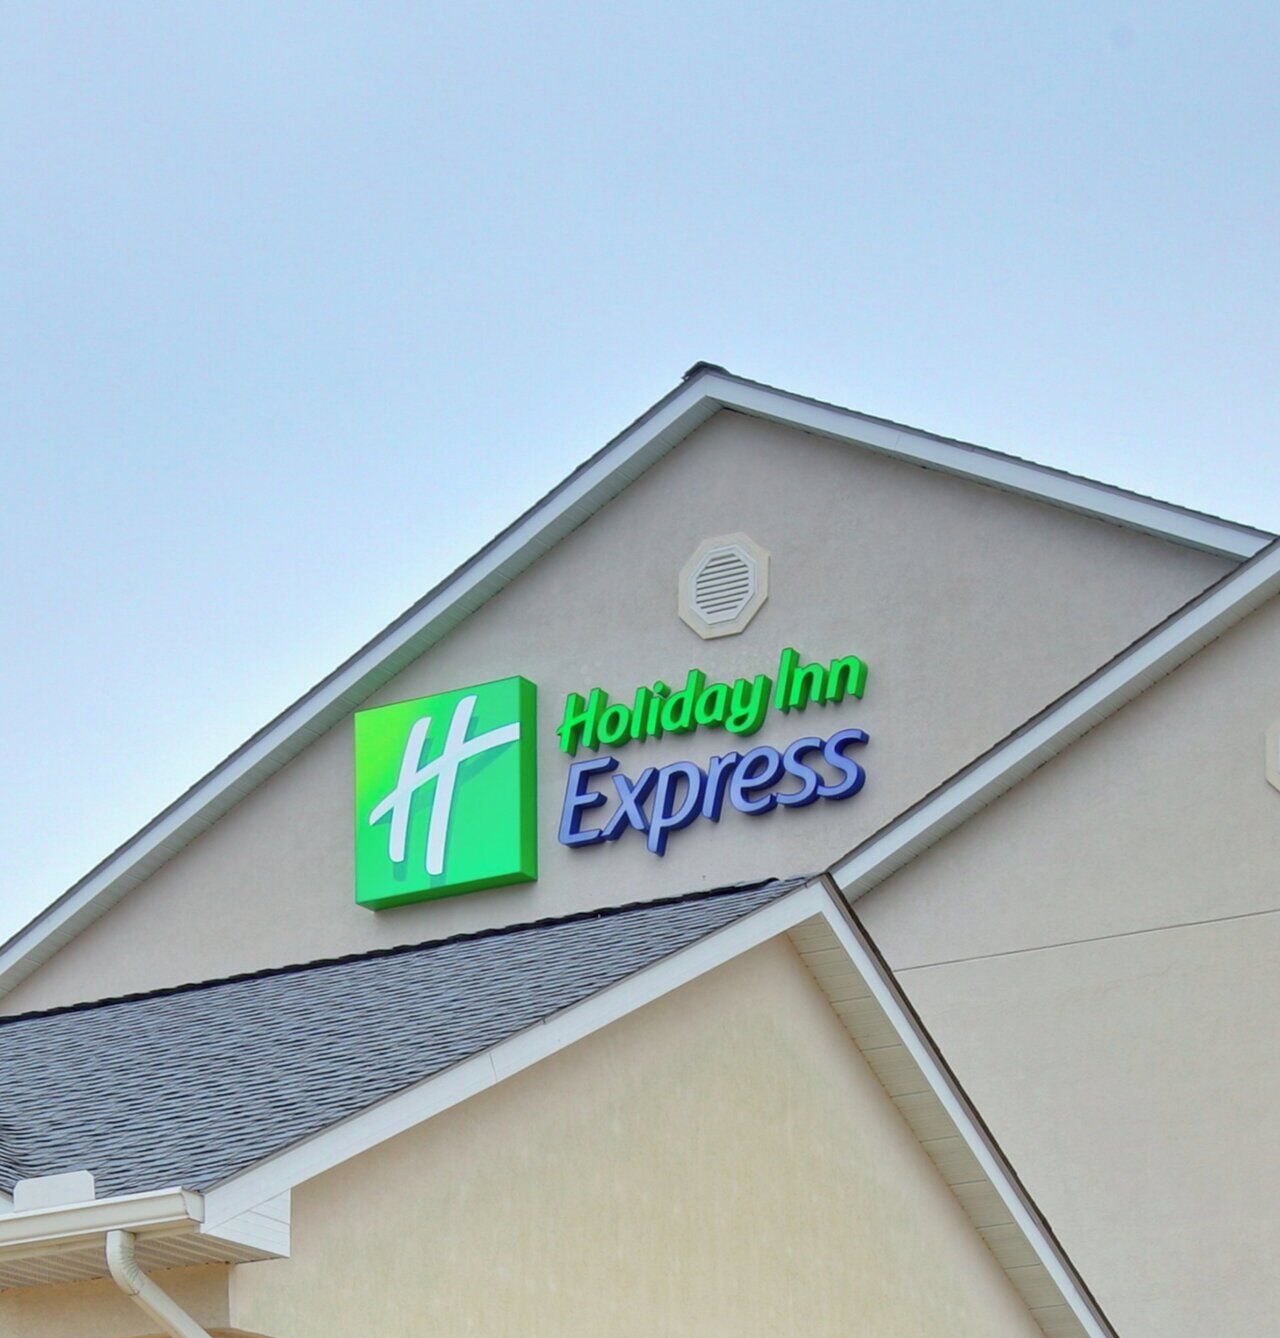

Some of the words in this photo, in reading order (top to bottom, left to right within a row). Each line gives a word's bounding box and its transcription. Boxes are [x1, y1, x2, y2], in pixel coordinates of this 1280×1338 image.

[556, 669, 772, 756] Holiday
[774, 647, 868, 714] Inn
[369, 694, 520, 876] H
[558, 728, 869, 857] Express
